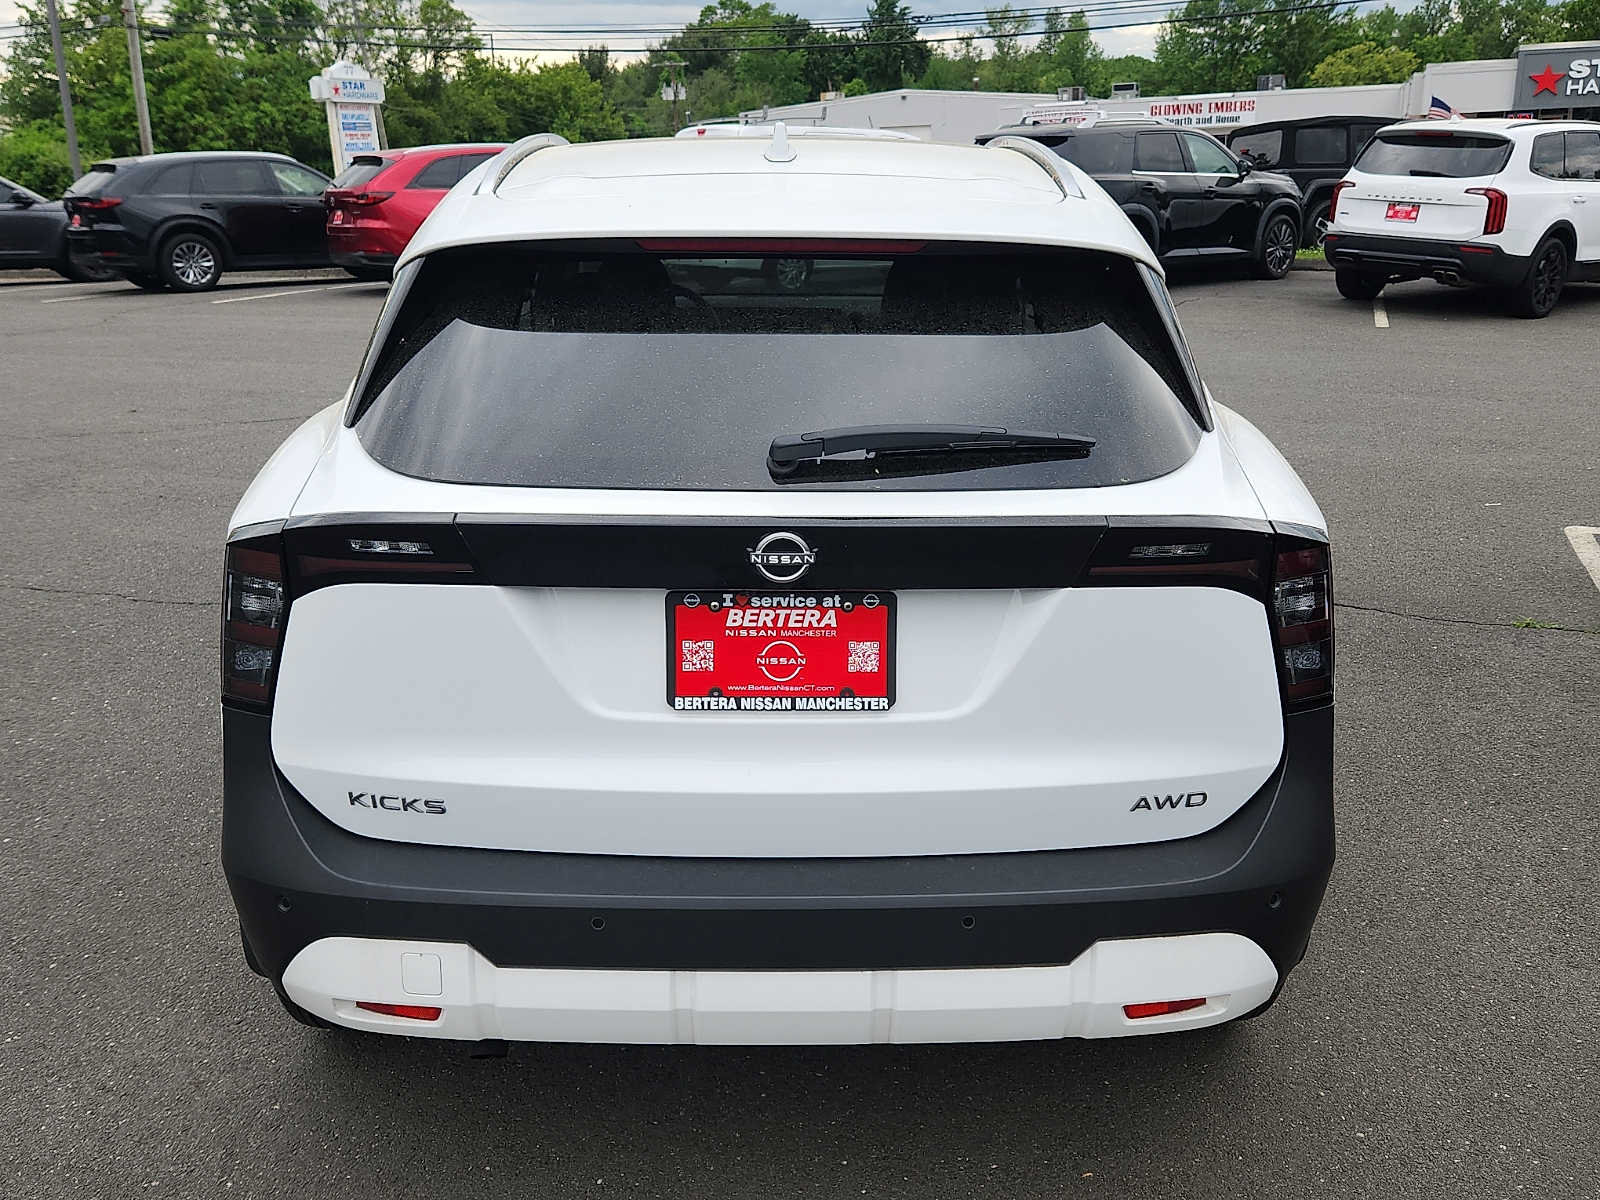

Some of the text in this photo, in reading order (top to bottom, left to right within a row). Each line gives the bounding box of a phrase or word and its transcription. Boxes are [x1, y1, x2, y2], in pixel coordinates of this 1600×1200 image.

[342, 81, 366, 90] STAR
[1150, 100, 1256, 116] GLOWING EMBERS
[1165, 117, 1193, 126] earth
[1195, 115, 1213, 124] and
[750, 554, 816, 564] NISSAN
[722, 593, 842, 608] I service at
[725, 609, 838, 628] BERTERA
[725, 629, 837, 637] NISSAN MANCHESTER
[756, 657, 807, 665] NISSAN
[727, 684, 835, 692] www.BerteraNissanCT.com
[674, 696, 890, 710] BERTERA NISSAN MANCHESTER
[347, 791, 448, 815] KICKS
[1129, 792, 1208, 812] AWD
